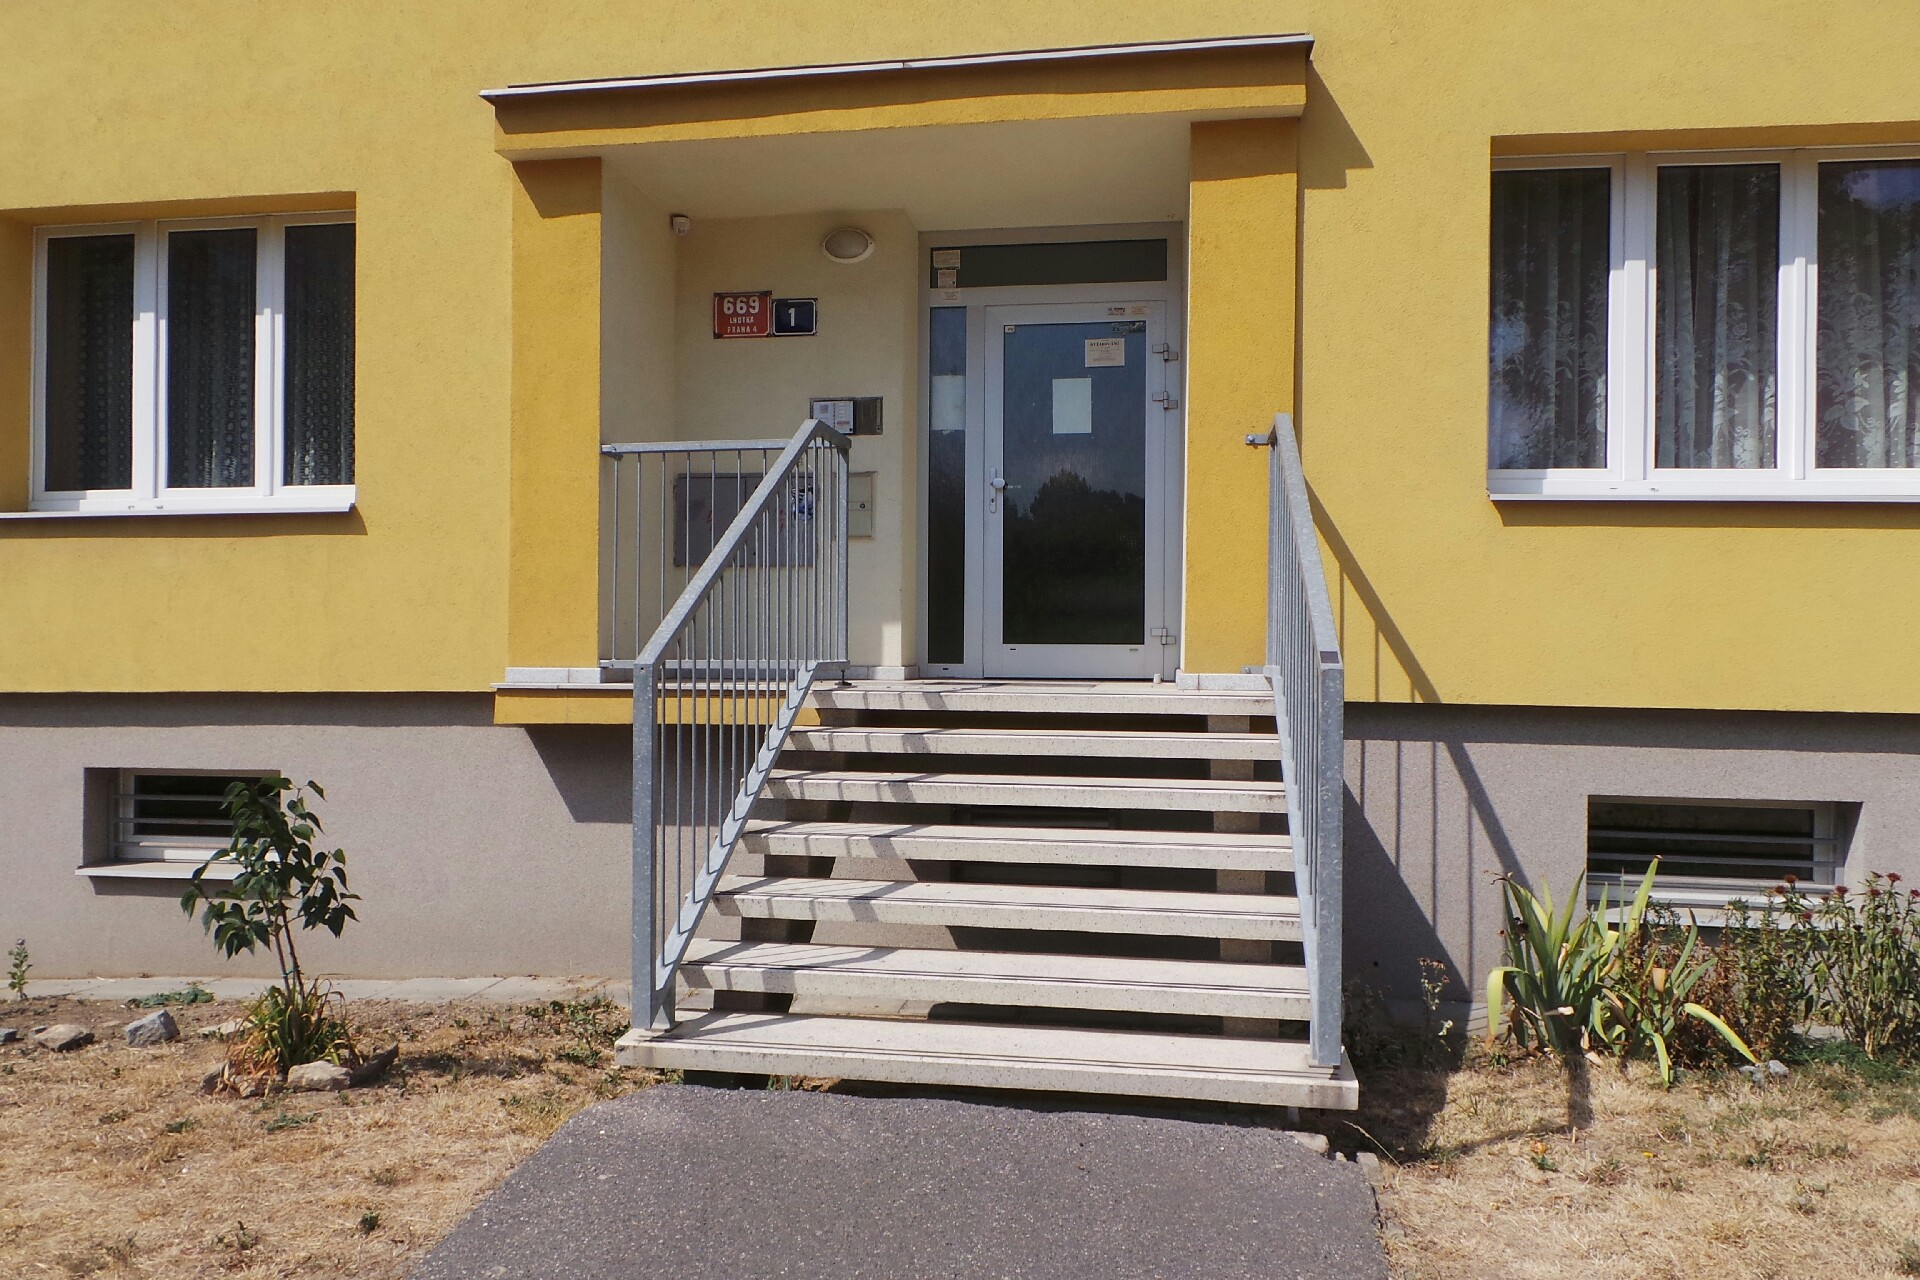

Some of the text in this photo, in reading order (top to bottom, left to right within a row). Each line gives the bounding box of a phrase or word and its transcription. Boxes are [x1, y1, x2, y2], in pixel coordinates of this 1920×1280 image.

[723, 296, 760, 315] 669
[729, 316, 754, 324] LHOTKA
[788, 307, 796, 327] 1
[752, 325, 757, 333] 4
